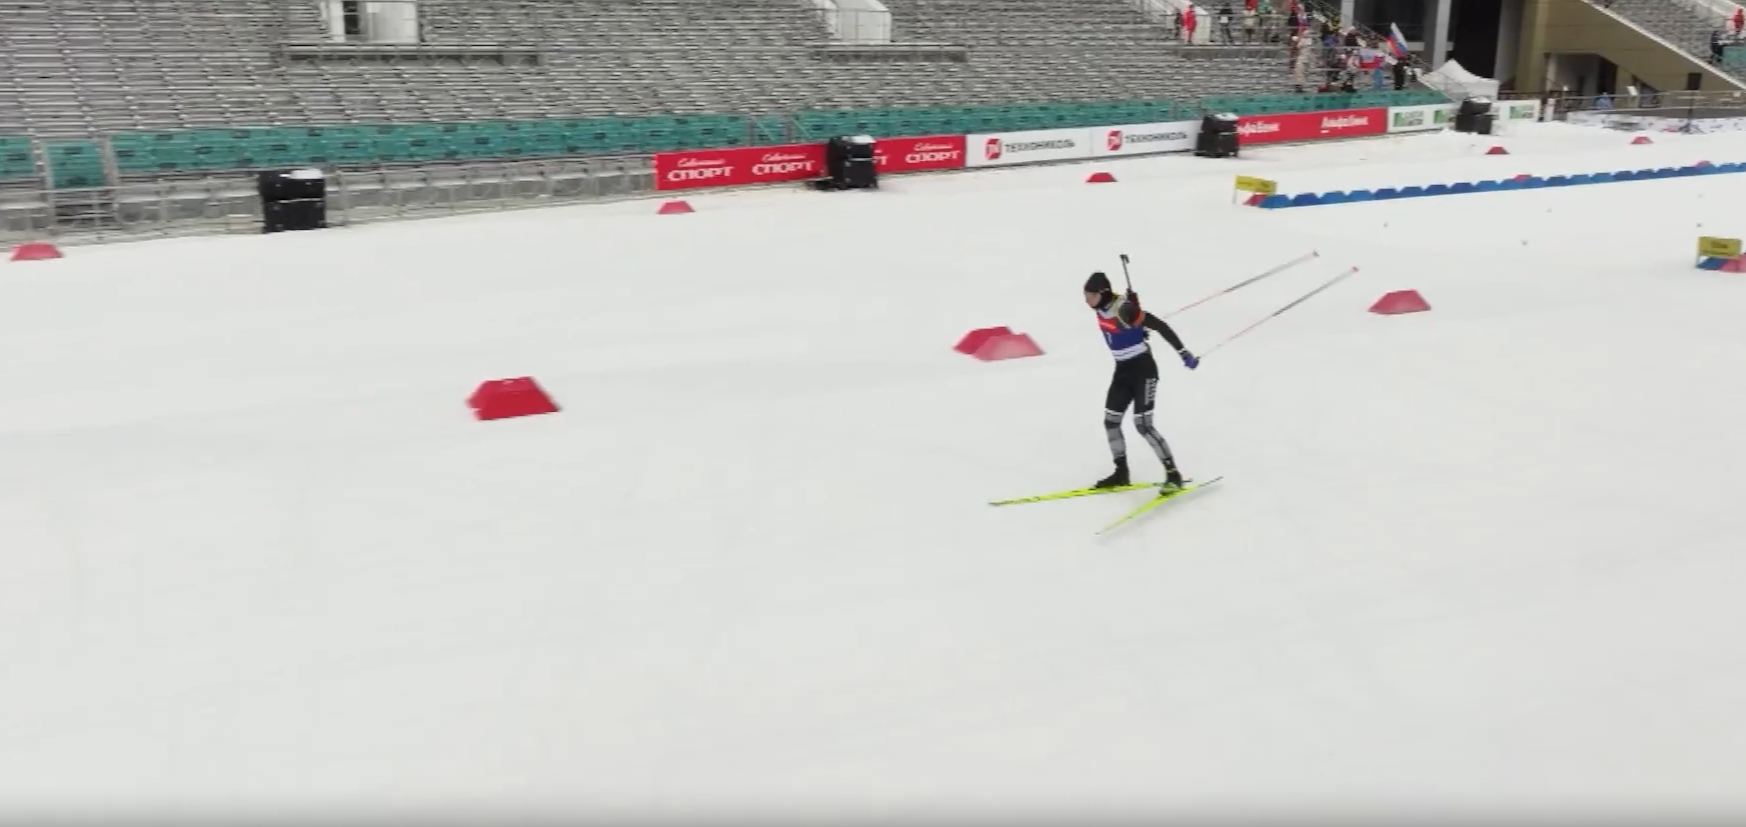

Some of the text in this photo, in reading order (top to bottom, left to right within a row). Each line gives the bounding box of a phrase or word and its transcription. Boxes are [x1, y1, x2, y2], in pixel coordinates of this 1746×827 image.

[904, 150, 960, 164] СПОРТ
[667, 166, 735, 182] СПОРТ
[752, 160, 815, 176] СПОРТ
